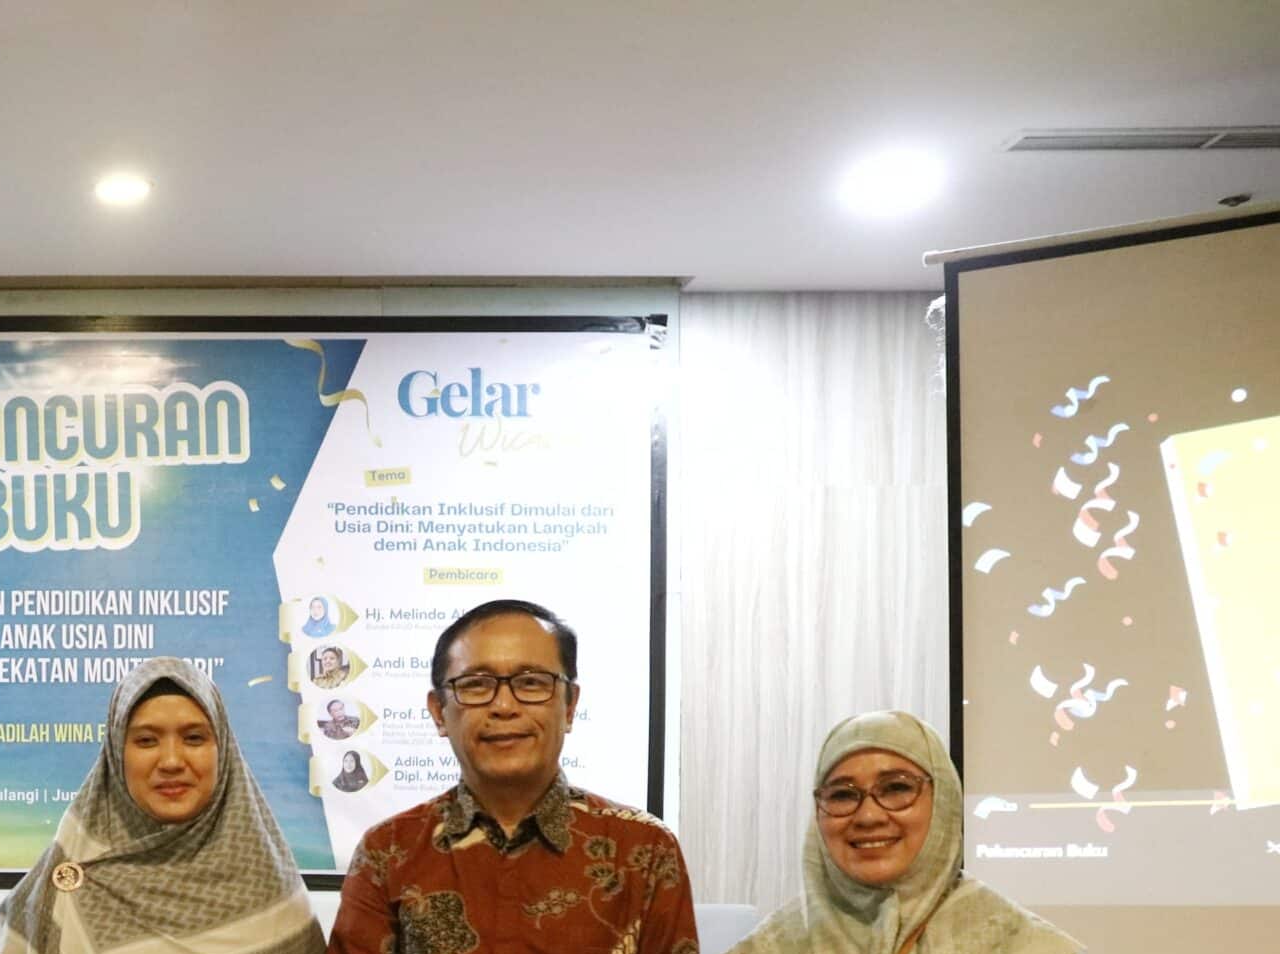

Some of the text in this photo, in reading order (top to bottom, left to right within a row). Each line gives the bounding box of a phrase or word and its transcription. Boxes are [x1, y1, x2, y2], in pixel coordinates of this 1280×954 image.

[396, 367, 541, 418] Gelar
[368, 469, 407, 482] Tema
[437, 502, 505, 517] Inklusif
[510, 502, 577, 517] Dimulai
[334, 520, 608, 538] Usia Dini: Menyatukan Langkah
[373, 537, 418, 552] demi
[422, 538, 468, 552] Anak
[428, 568, 499, 582] Pembicara
[10, 590, 136, 616] PENDIDIKAN
[138, 590, 230, 615] INKLUSIF
[365, 607, 385, 622] Hj.
[389, 607, 447, 620] Melinda
[0, 624, 56, 649] ANAK
[61, 624, 108, 649] USIA
[113, 623, 155, 649] DINI
[372, 657, 405, 669] Andi
[383, 708, 416, 720] Prof.
[54, 723, 94, 743] WINA
[394, 756, 434, 767] Adilah
[394, 770, 422, 783] Dipl.
